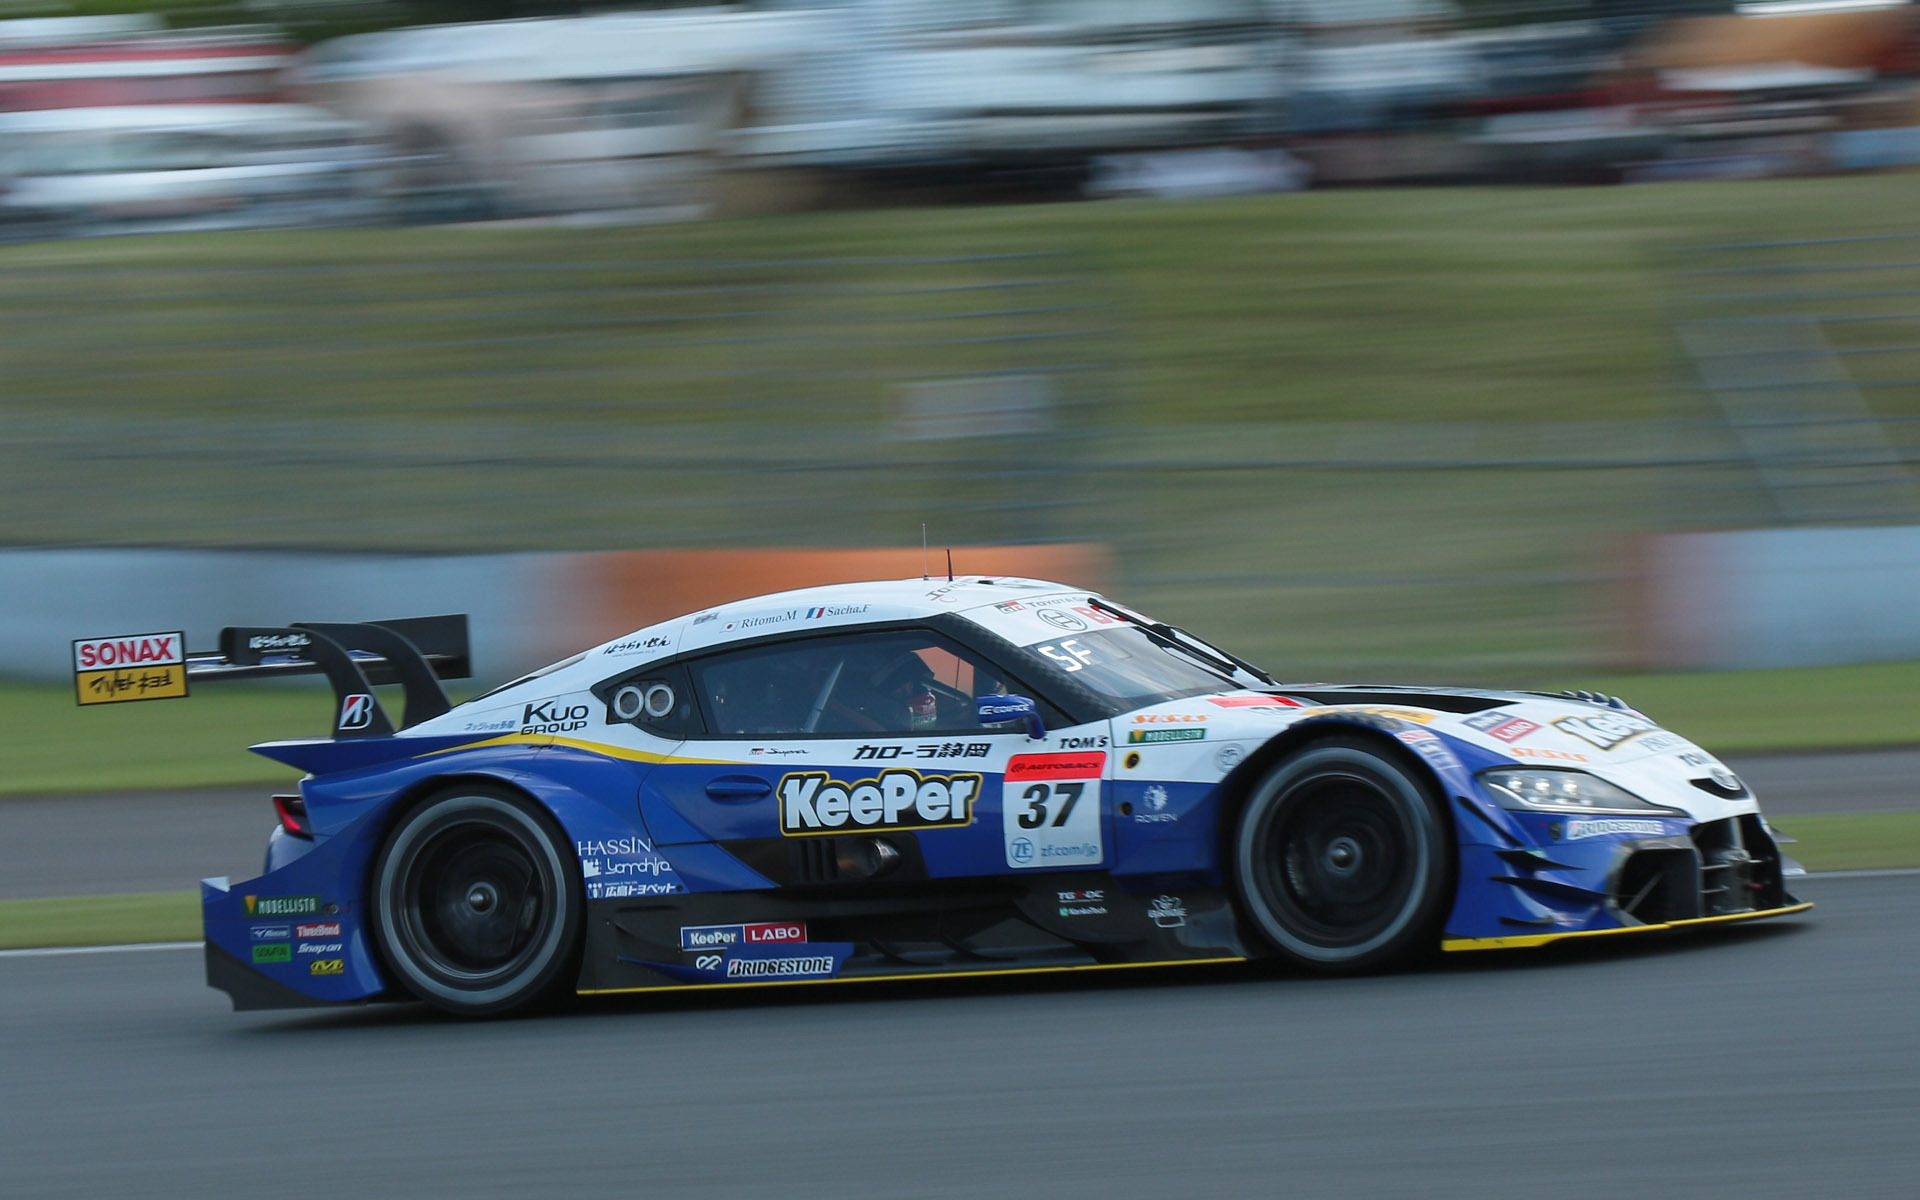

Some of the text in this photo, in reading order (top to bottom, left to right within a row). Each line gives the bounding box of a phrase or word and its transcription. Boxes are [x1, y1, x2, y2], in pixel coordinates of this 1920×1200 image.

[741, 610, 798, 629] Ritomo.M
[826, 604, 871, 617] Sacha.F
[80, 637, 174, 667] SONAX
[520, 720, 588, 735] GROUP
[853, 743, 992, 760] カローラ静岡
[783, 774, 976, 829] KeePer
[1018, 783, 1085, 829] 37
[577, 836, 652, 856] HASSIN
[690, 927, 800, 945] KeePer LABO
[727, 956, 833, 978] BRIDGESTONE
